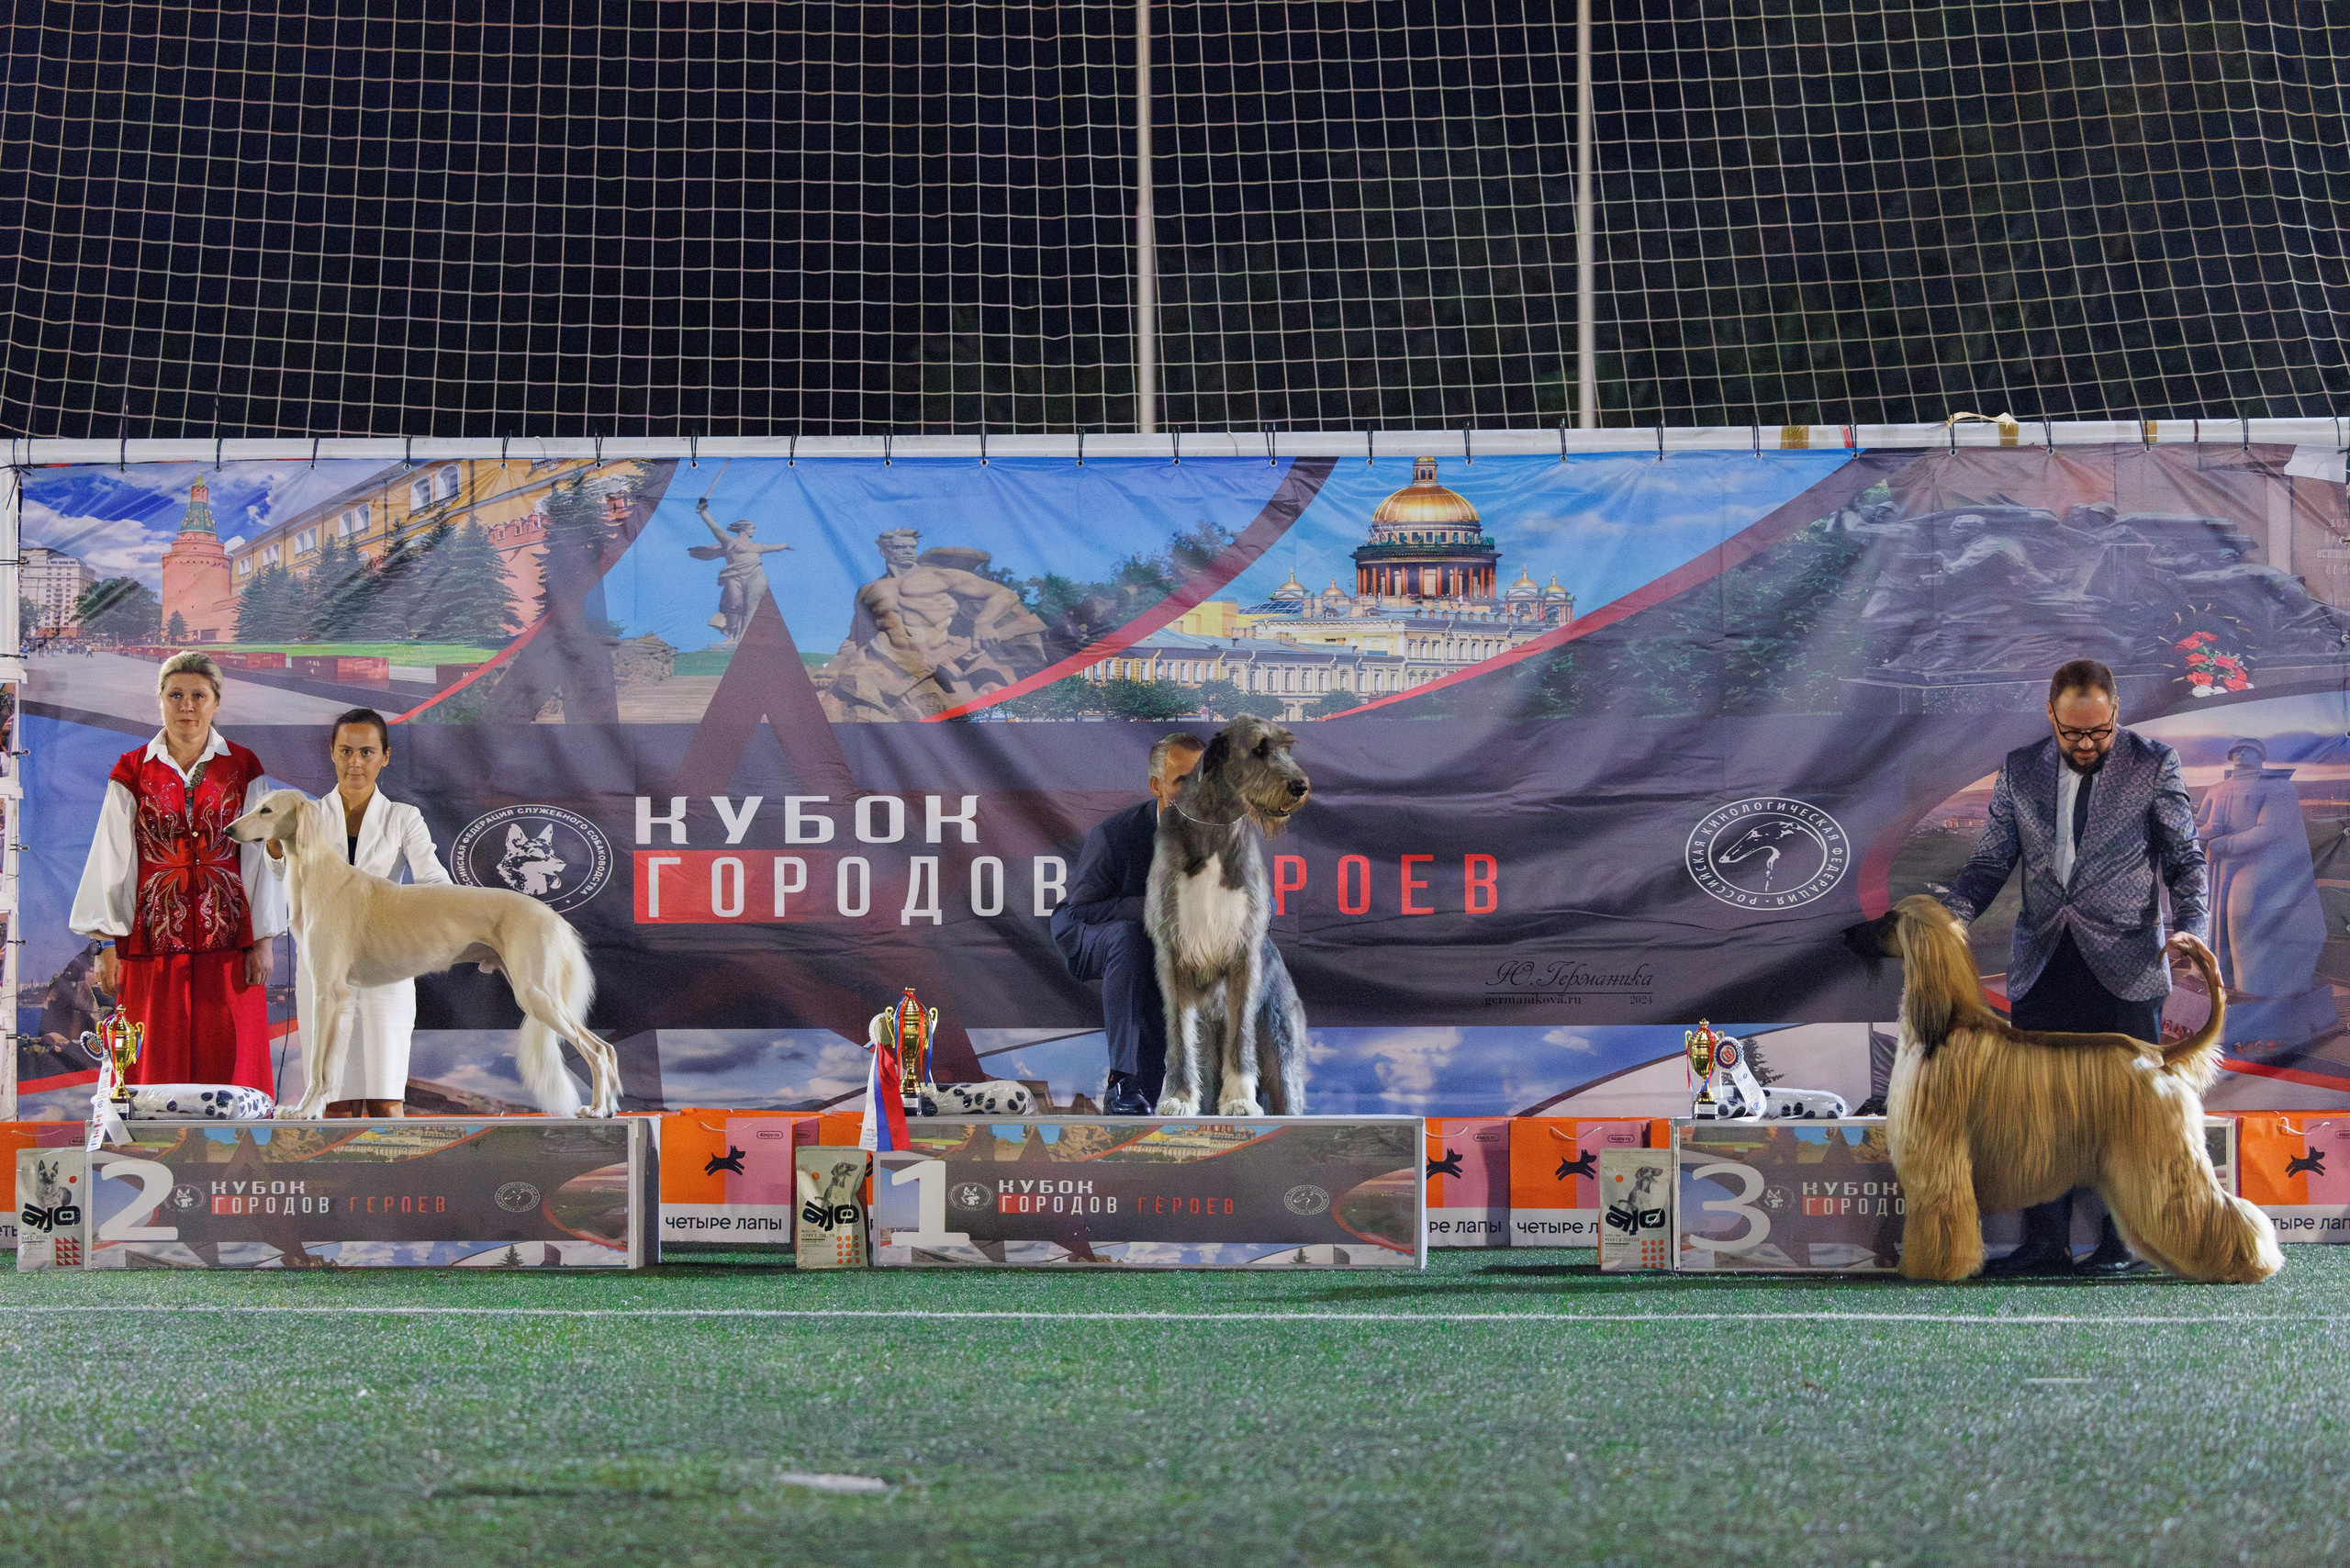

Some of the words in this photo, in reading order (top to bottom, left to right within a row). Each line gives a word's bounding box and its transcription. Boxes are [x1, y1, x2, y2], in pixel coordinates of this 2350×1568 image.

[463, 810, 514, 844] ФЕДЕРАЦИЯ
[517, 807, 588, 830] СЛУЖЕБНОГО
[634, 795, 980, 846] КУБОК
[1701, 801, 1840, 841] КИНОЛОГИЧЕСКАЯ
[456, 845, 474, 886] ССИЙСКАЯ
[580, 830, 607, 895] СОБАКОВОДСТВА
[1693, 840, 1757, 905] РОССИЙСКАЯ
[1776, 847, 1844, 905] ФЕДЕРАЦИЯ
[647, 855, 1067, 925] ГОРОДОВ
[1274, 852, 1498, 916] РОЕВ
[211, 1181, 305, 1194] КУБОК
[999, 1180, 1093, 1193] КУБОК
[1803, 1182, 1898, 1195] КУБОК
[98, 1160, 178, 1242] 2
[215, 1196, 330, 1215] ГОРОДОВ
[891, 1160, 970, 1248] 1
[1002, 1196, 1117, 1215] ГОРОДОВ
[1138, 1196, 1234, 1215] ГЕРОЕВ
[1689, 1163, 1772, 1252] 3
[1806, 1198, 1906, 1216] ГОРОДО
[666, 1216, 732, 1229] четыре
[736, 1217, 782, 1230] лапы
[1455, 1221, 1502, 1233] лапы
[1517, 1221, 1584, 1234] четыре
[2270, 1217, 2314, 1230] тыре
[2320, 1217, 2350, 1230] лап
